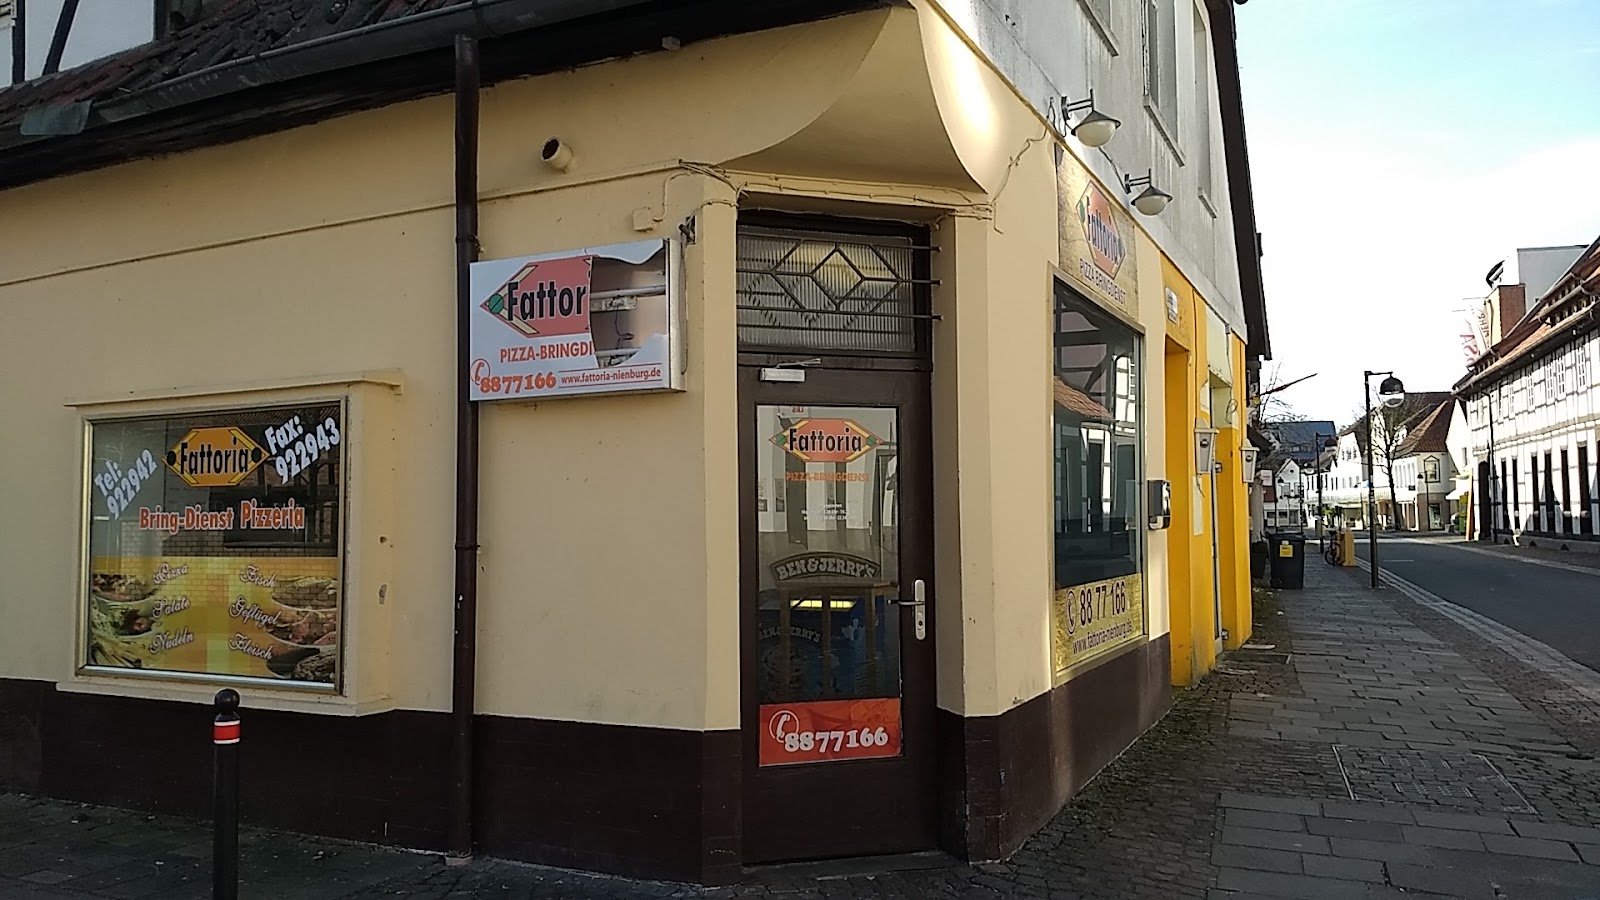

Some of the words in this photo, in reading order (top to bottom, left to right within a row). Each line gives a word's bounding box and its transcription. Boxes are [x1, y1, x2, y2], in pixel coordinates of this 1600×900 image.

[1086, 194, 1122, 266] Fattoria
[507, 273, 590, 321] Fattor
[480, 371, 557, 394] 8877166
[561, 367, 661, 385] www.fattoria-nienburg.de
[264, 414, 304, 455] Fax:
[275, 416, 340, 485] 922943
[789, 427, 862, 452] Fattoria
[180, 436, 249, 475] Fattoria
[94, 460, 122, 497] Tel:
[105, 449, 158, 520] 922942
[139, 504, 234, 535] Bring-Dienst
[240, 497, 305, 530] Pizzeria
[153, 562, 189, 585] Pizza
[239, 565, 276, 588] Fisch
[152, 596, 191, 619] Salate
[229, 595, 281, 630] Geflügel
[1080, 588, 1092, 627] 88
[1095, 584, 1107, 621] 77
[1110, 580, 1126, 615] 166
[150, 628, 194, 654] Nudeln
[229, 633, 273, 660] Fleisch
[784, 727, 889, 753] 8877166
